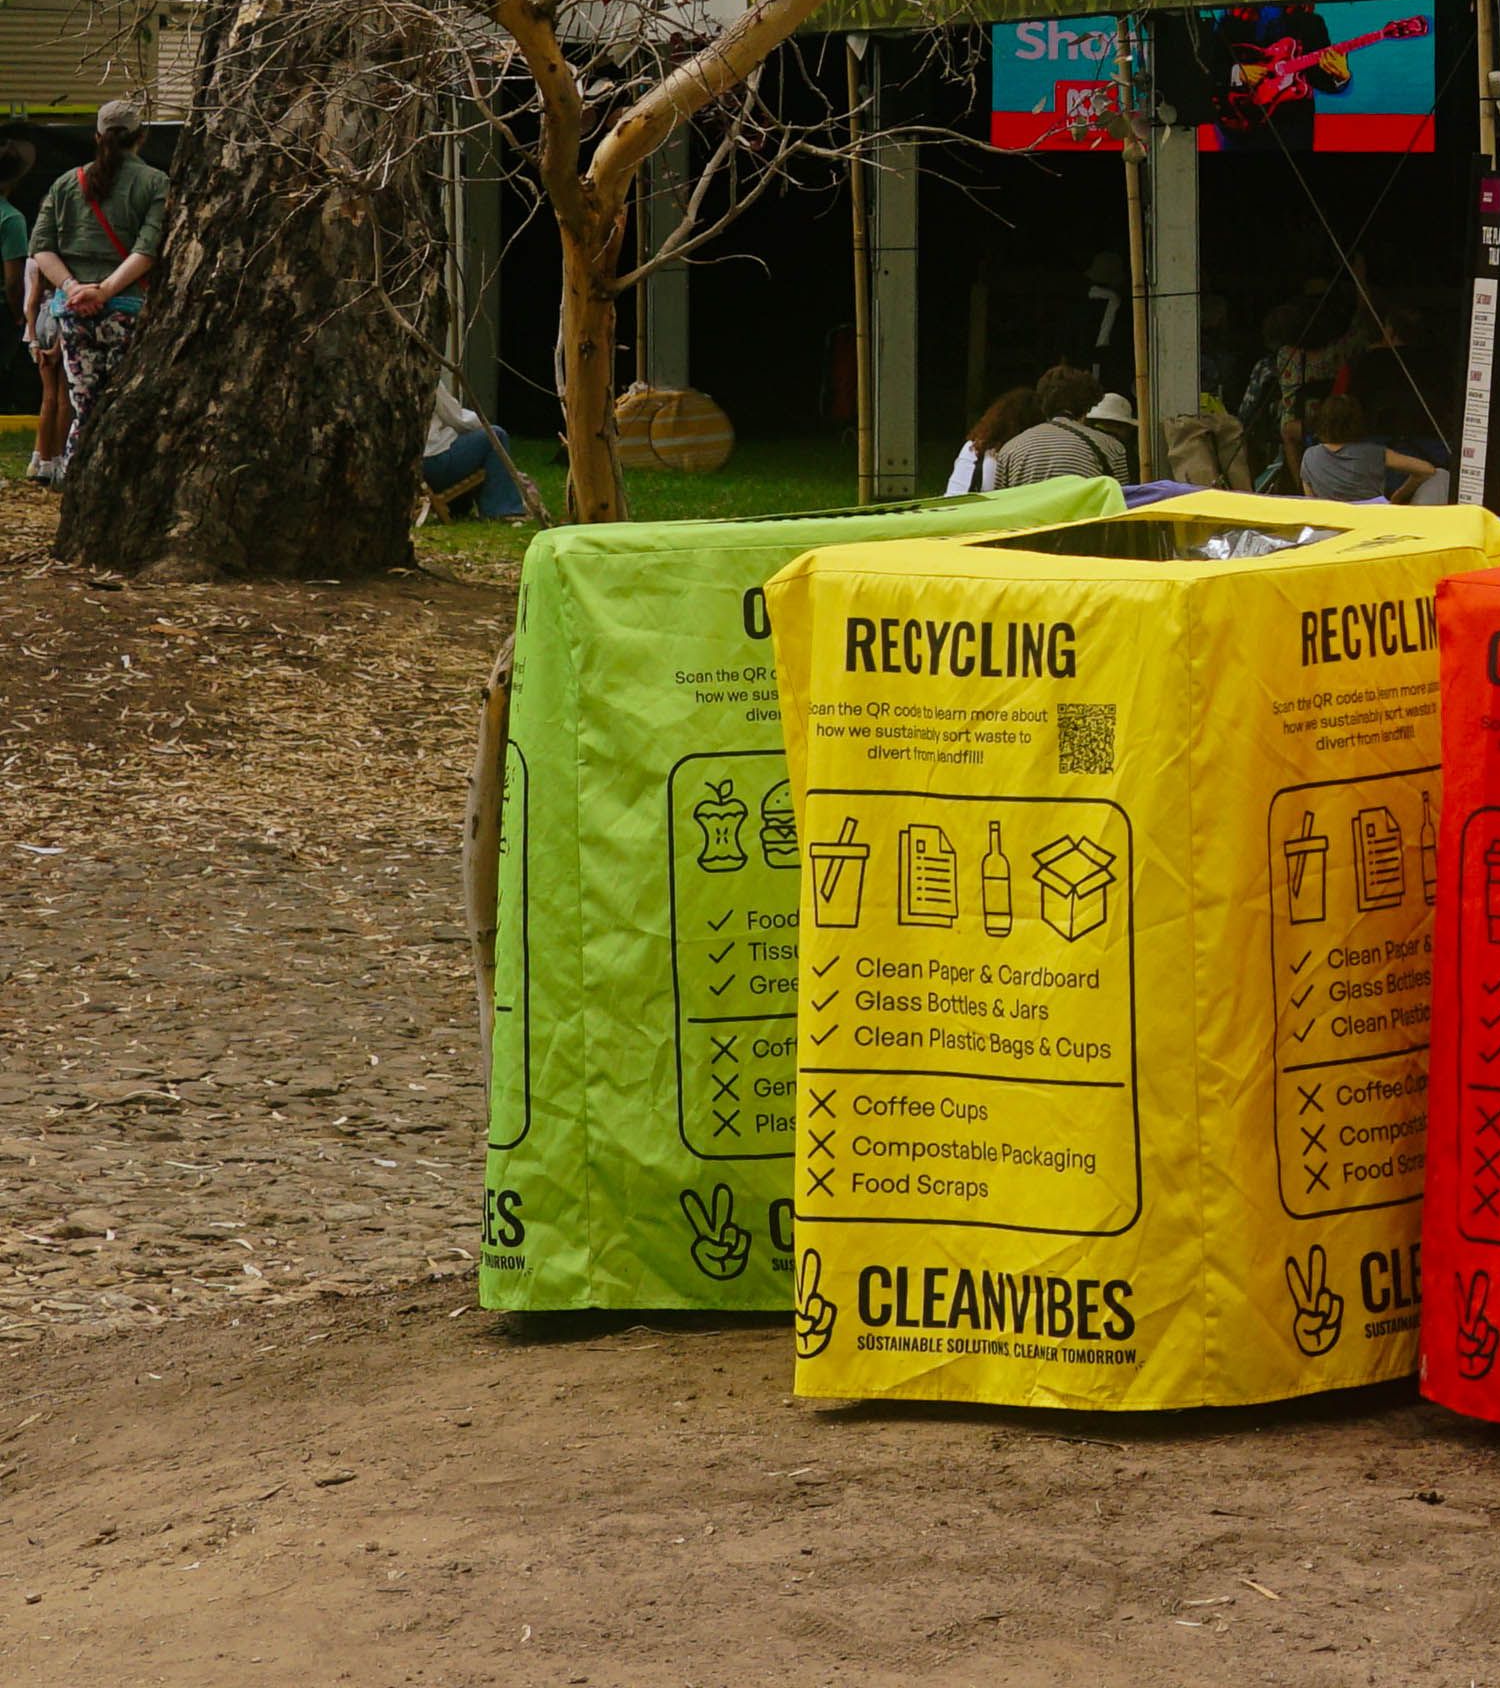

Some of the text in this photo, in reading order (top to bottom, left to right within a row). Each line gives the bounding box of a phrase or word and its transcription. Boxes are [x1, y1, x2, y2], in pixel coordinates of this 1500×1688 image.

[1302, 595, 1438, 667] RECYCLIN
[845, 617, 1076, 678] RECYCLING
[838, 702, 862, 716] the
[866, 702, 890, 719] QR
[894, 704, 921, 718] code
[923, 706, 933, 719] to
[934, 706, 966, 721] learn
[971, 710, 1008, 722] more
[1012, 708, 1048, 723] about
[817, 723, 844, 738] how
[849, 726, 870, 738] we
[942, 729, 971, 743] sort
[975, 731, 1016, 744] waste
[1020, 732, 1031, 744] to
[868, 746, 912, 761] divert
[748, 909, 799, 930] Food
[855, 957, 1100, 989] Clean Paper & Cardboard
[855, 990, 1048, 1020] Glass Bottles & Jars
[854, 1025, 1111, 1063] Clean Plastic Bags & Cups
[852, 1095, 988, 1124] Coffee Cups
[852, 1136, 1096, 1174] Compostable Packaging
[852, 1173, 989, 1201] Food Scraps
[858, 1265, 1136, 1341] CLEANVIBES
[857, 1334, 943, 1353] SUSTAINABLE
[1014, 1344, 1058, 1361] CLEANER
[1062, 1347, 1137, 1365] TOMORROW
